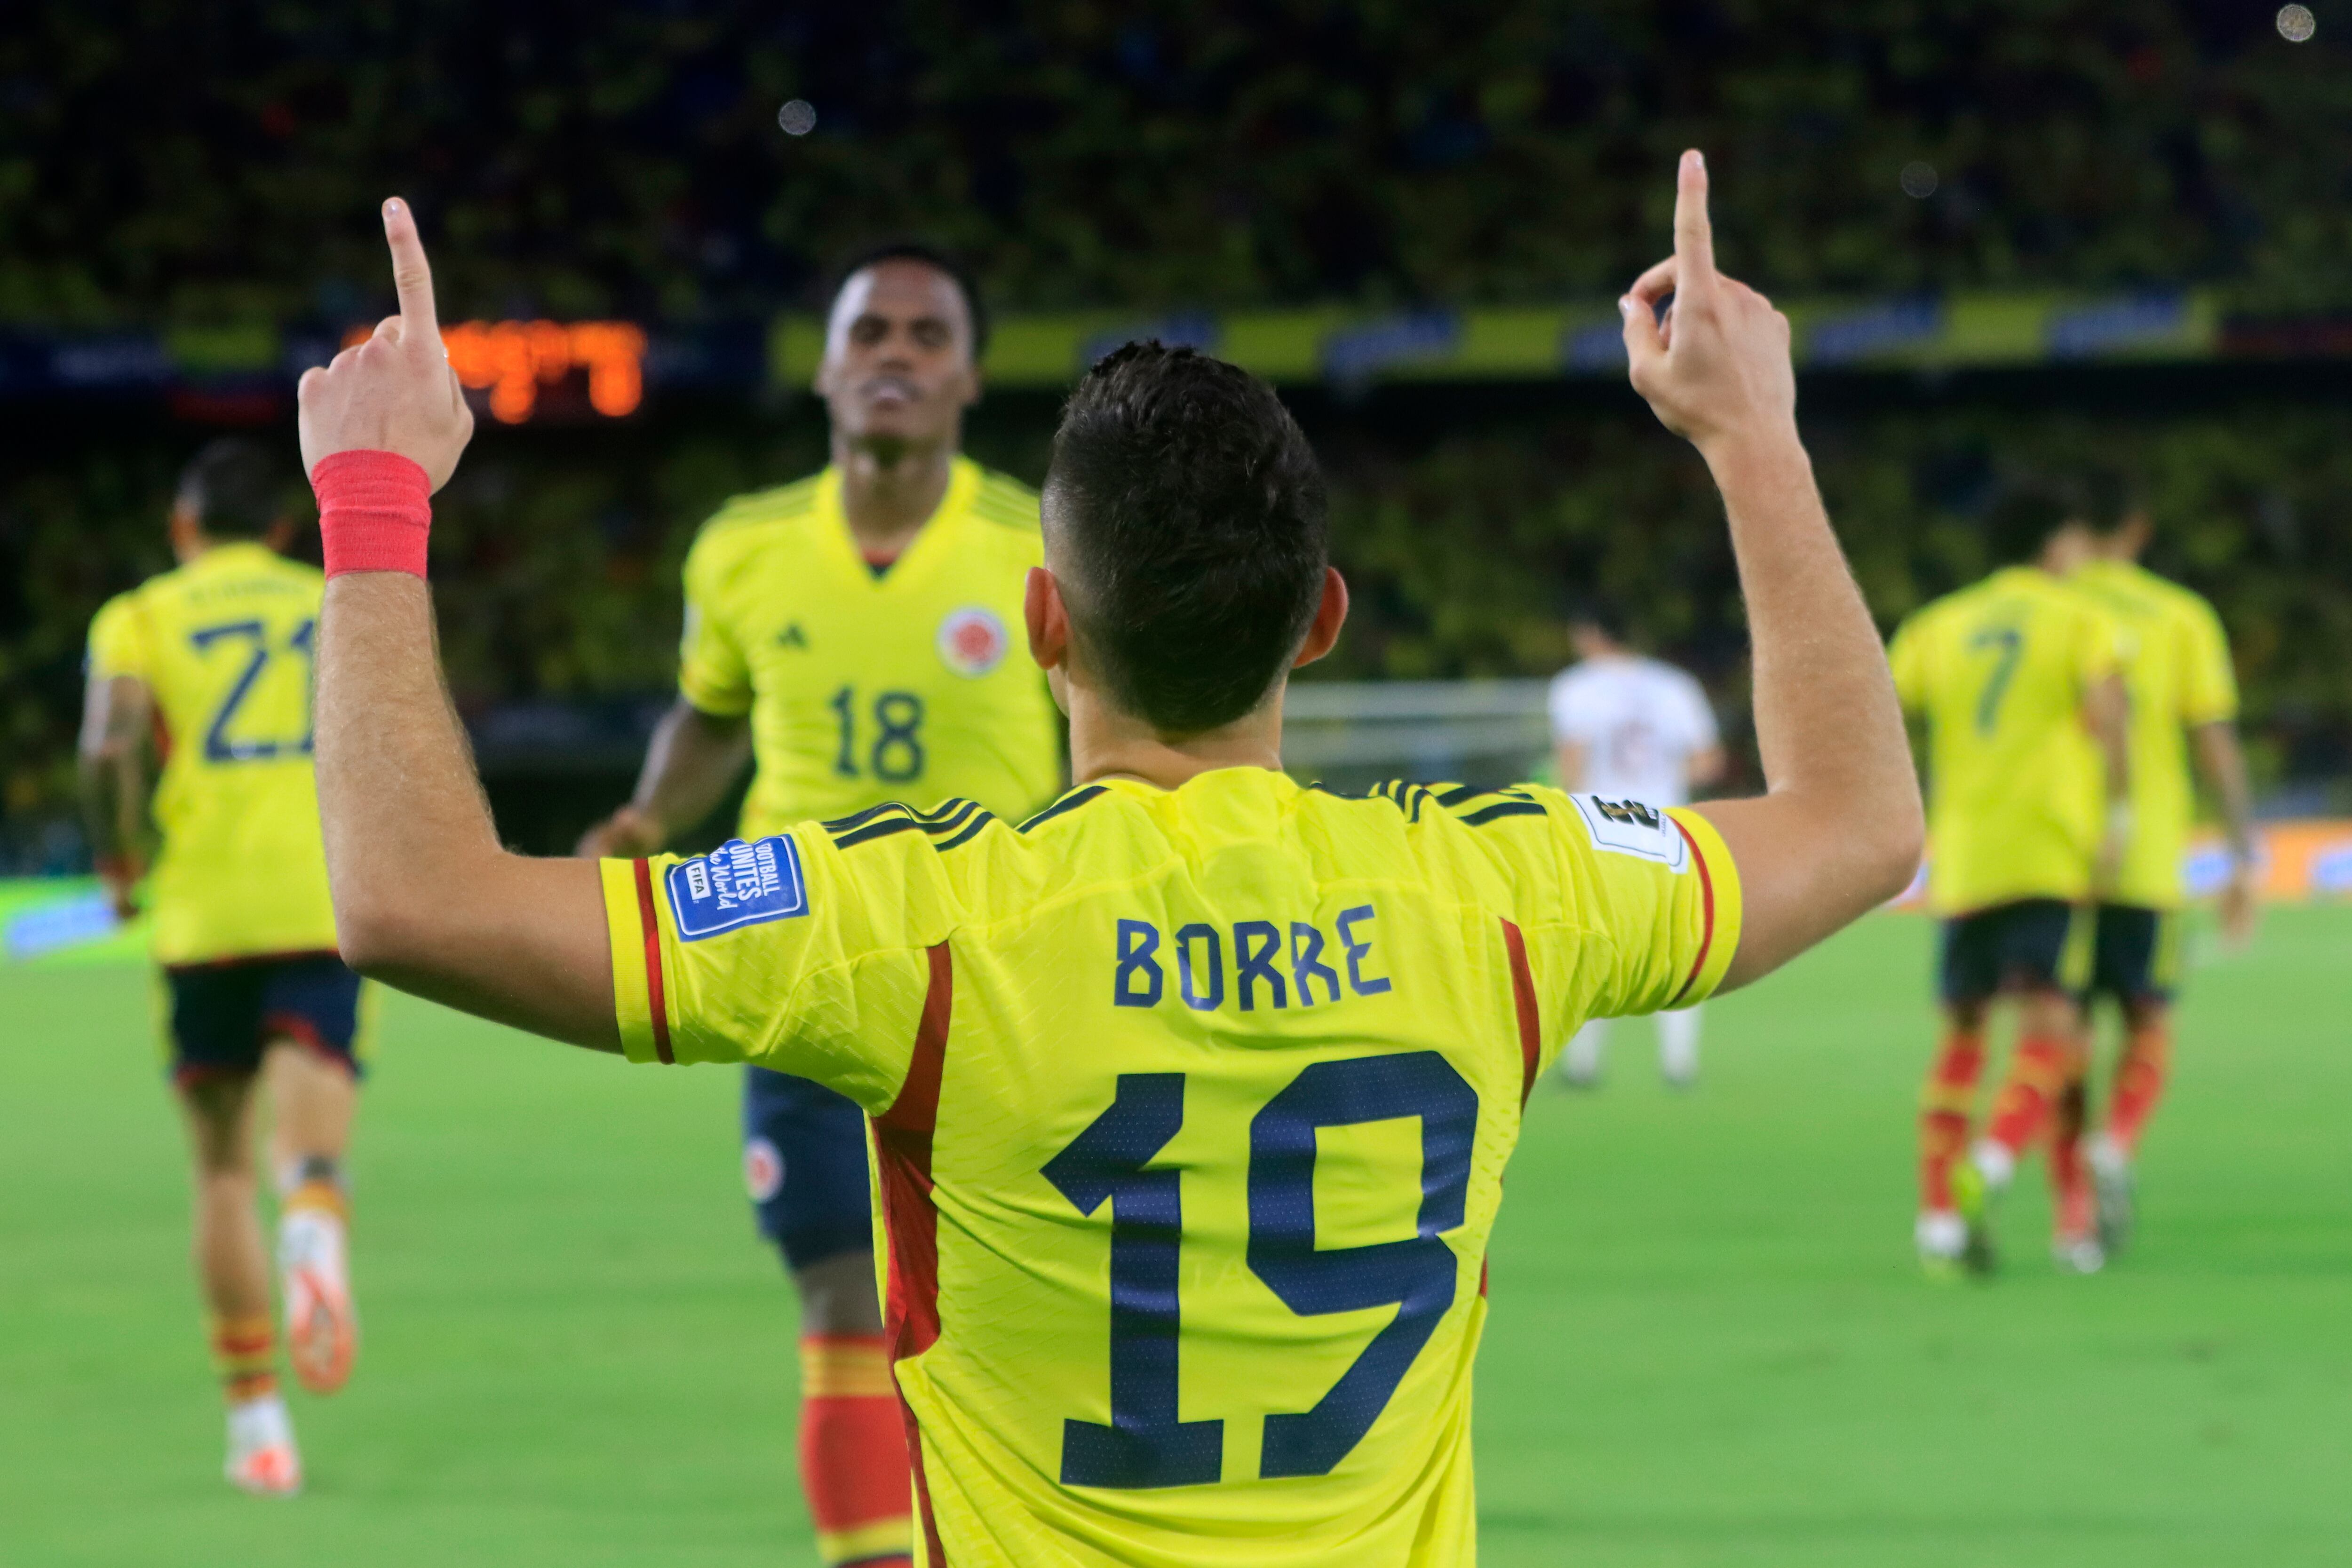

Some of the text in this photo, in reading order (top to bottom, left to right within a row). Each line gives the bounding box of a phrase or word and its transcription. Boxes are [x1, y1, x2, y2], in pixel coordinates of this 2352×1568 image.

[1966, 626, 2024, 735] 7
[829, 684, 926, 784] 18
[691, 867, 705, 895] FIFA
[709, 847, 739, 911] the World
[729, 844, 762, 901] UNITES
[755, 842, 780, 896] FOOTBALL
[1113, 904, 1392, 1012] BORRE
[1038, 1050, 1478, 1489] 19
